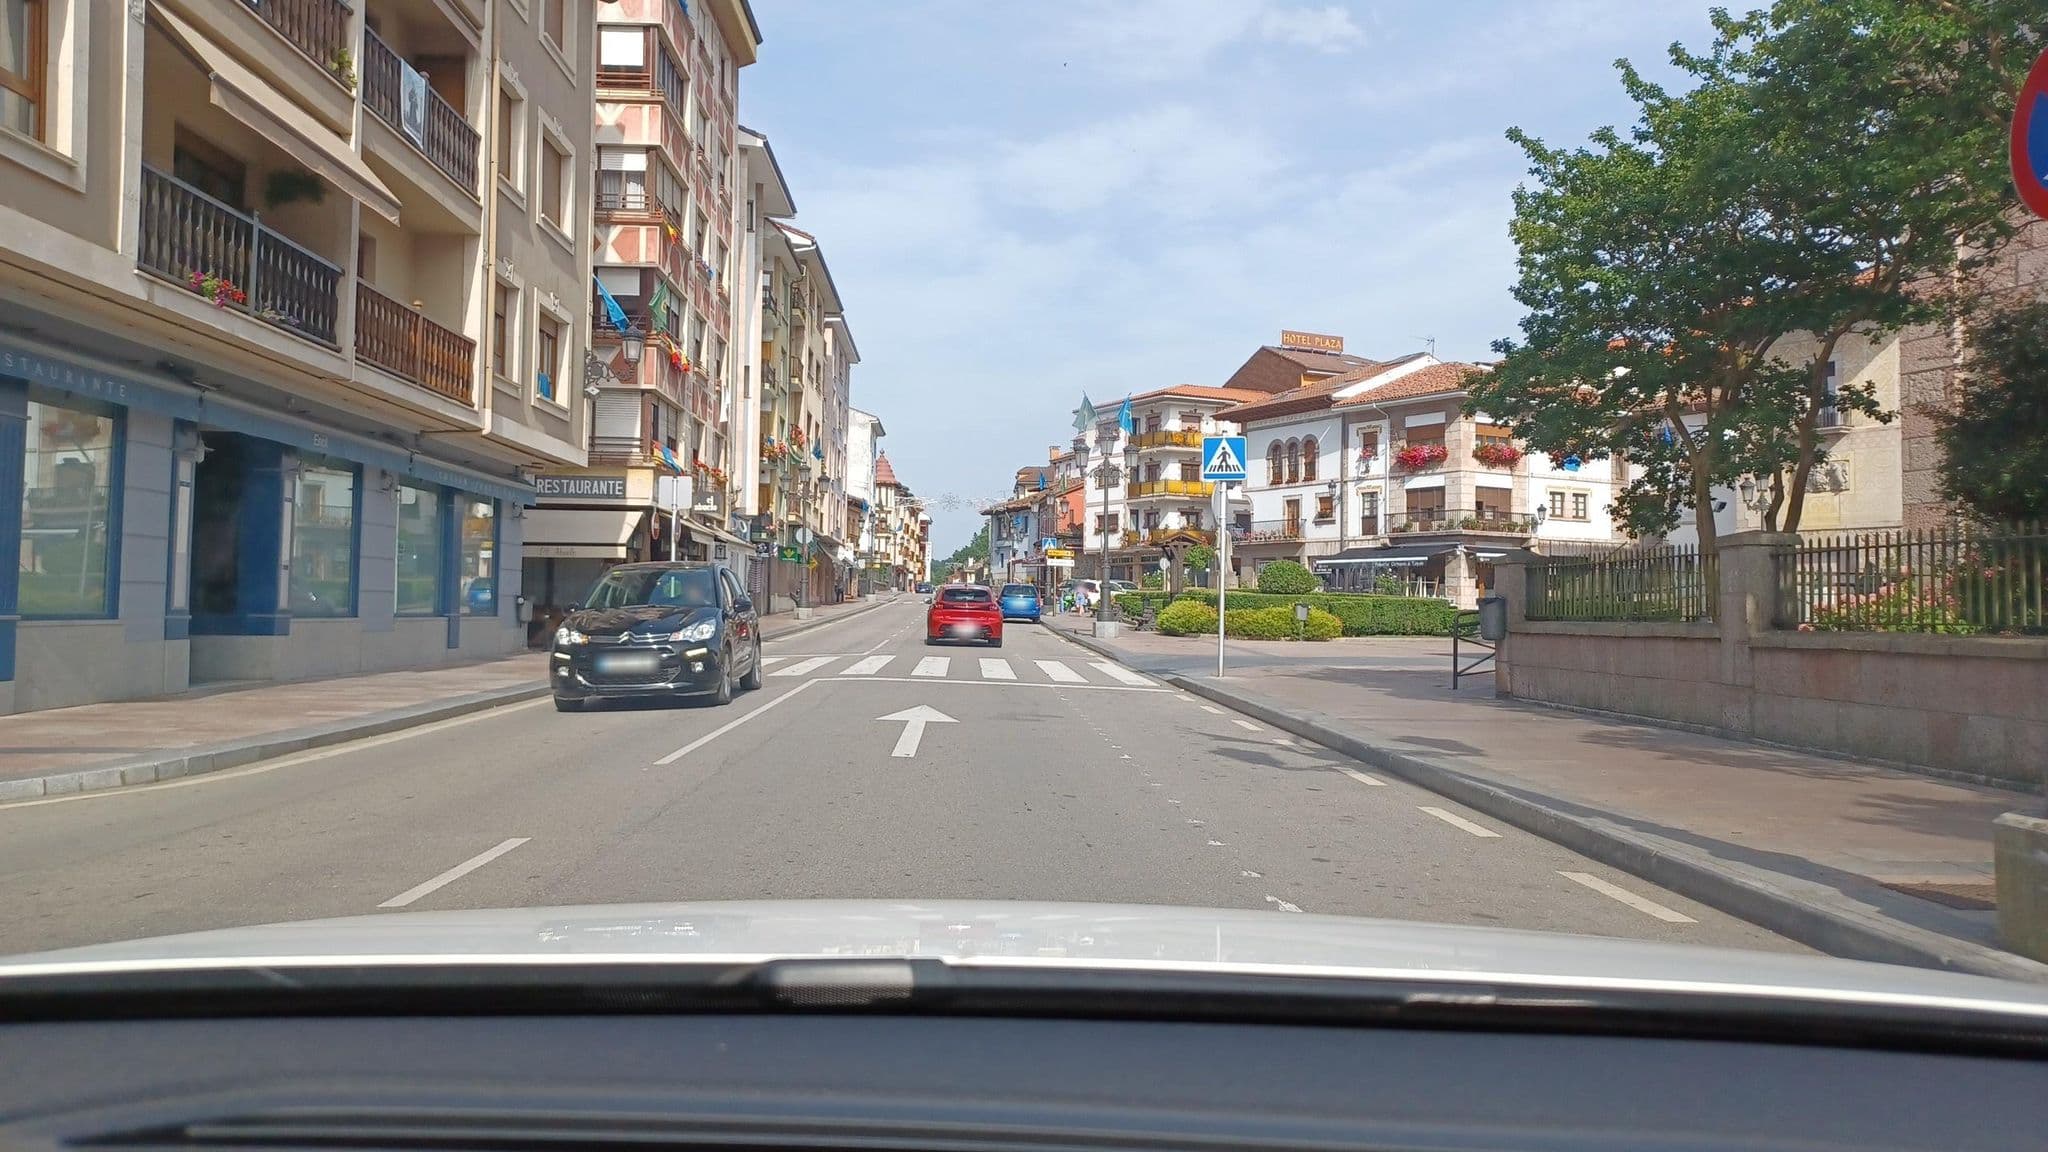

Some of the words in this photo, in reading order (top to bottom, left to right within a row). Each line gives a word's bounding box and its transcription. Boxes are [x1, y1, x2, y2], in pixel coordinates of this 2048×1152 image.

[1283, 333, 1312, 345] HOTEL
[1314, 337, 1342, 350] PLAZA
[536, 478, 624, 495] RESTAURANTE
